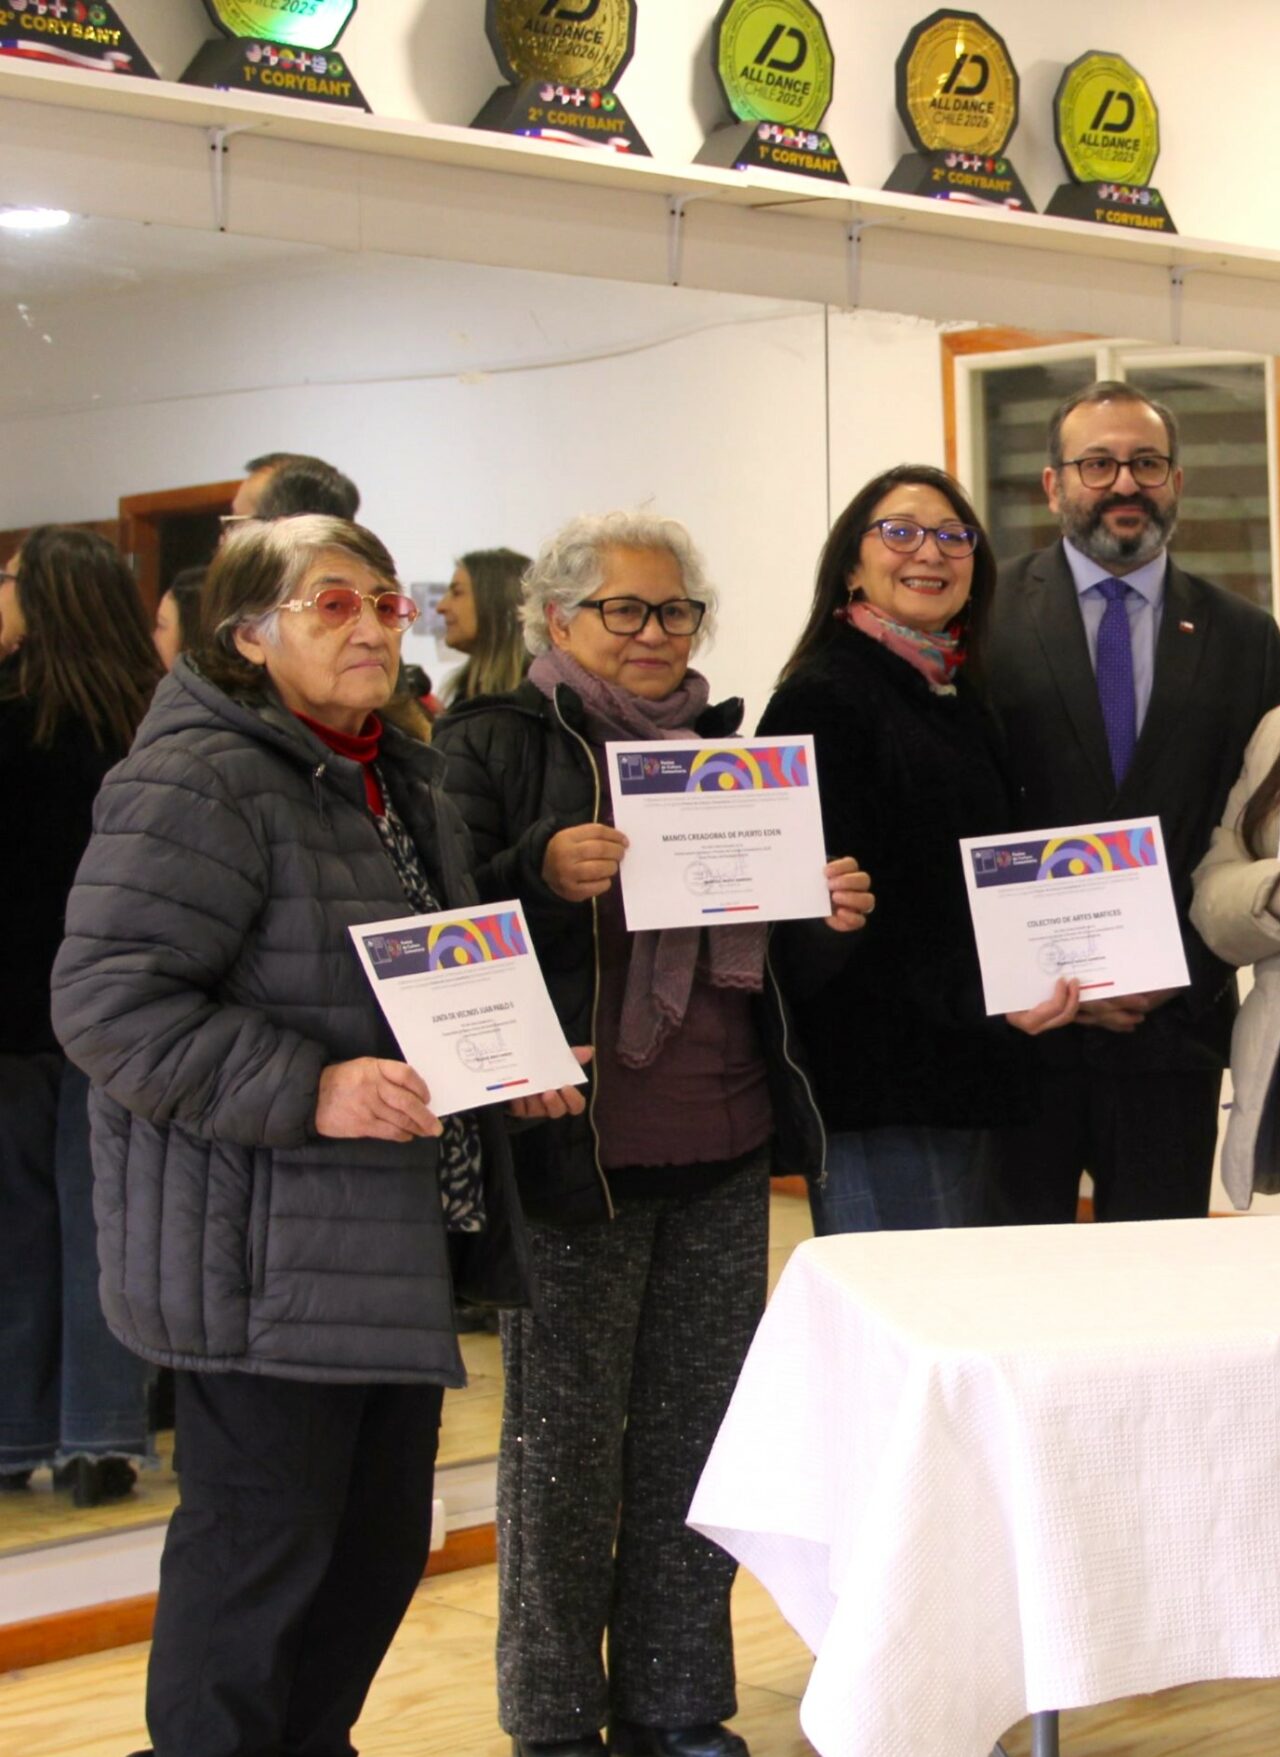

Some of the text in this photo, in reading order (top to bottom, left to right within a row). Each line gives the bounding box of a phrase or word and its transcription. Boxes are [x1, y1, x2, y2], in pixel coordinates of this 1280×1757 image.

[20, 13, 121, 46] CORYBANT
[522, 18, 604, 45] ALL DANCE
[261, 68, 351, 97] CORYBANT
[740, 65, 811, 96] ALL DANCE
[776, 90, 804, 107] 2025
[929, 97, 995, 114] ALL DANCE
[547, 110, 626, 133] CORYBANT
[932, 111, 963, 126] CHILE
[1078, 133, 1140, 152] ALL DANCE
[772, 148, 839, 173] CORYBANT
[947, 169, 1013, 192] CORYBANT
[1106, 210, 1166, 230] CORYBANT
[662, 833, 687, 842] MANOS
[688, 831, 727, 841] CREADORAS
[727, 830, 737, 839] DE
[738, 829, 763, 838] PUERTO
[1026, 908, 1122, 928] COLECTIVO DE ARTES MATICES
